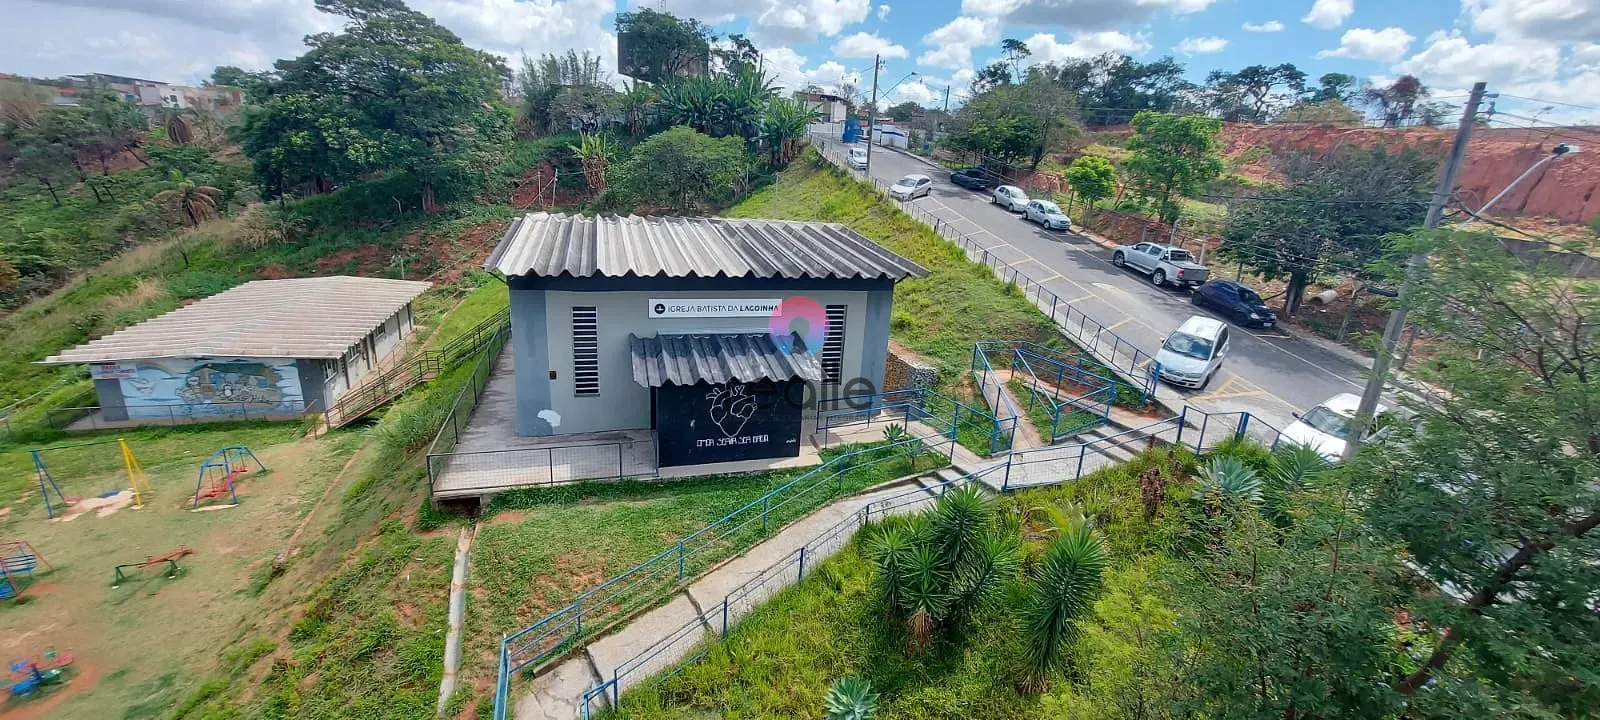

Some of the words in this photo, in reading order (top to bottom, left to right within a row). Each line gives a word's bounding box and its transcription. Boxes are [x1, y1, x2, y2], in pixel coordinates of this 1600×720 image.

[668, 305, 696, 313] IGREJA
[697, 305, 727, 313] BATISTA
[740, 304, 779, 312] LAGOINHA
